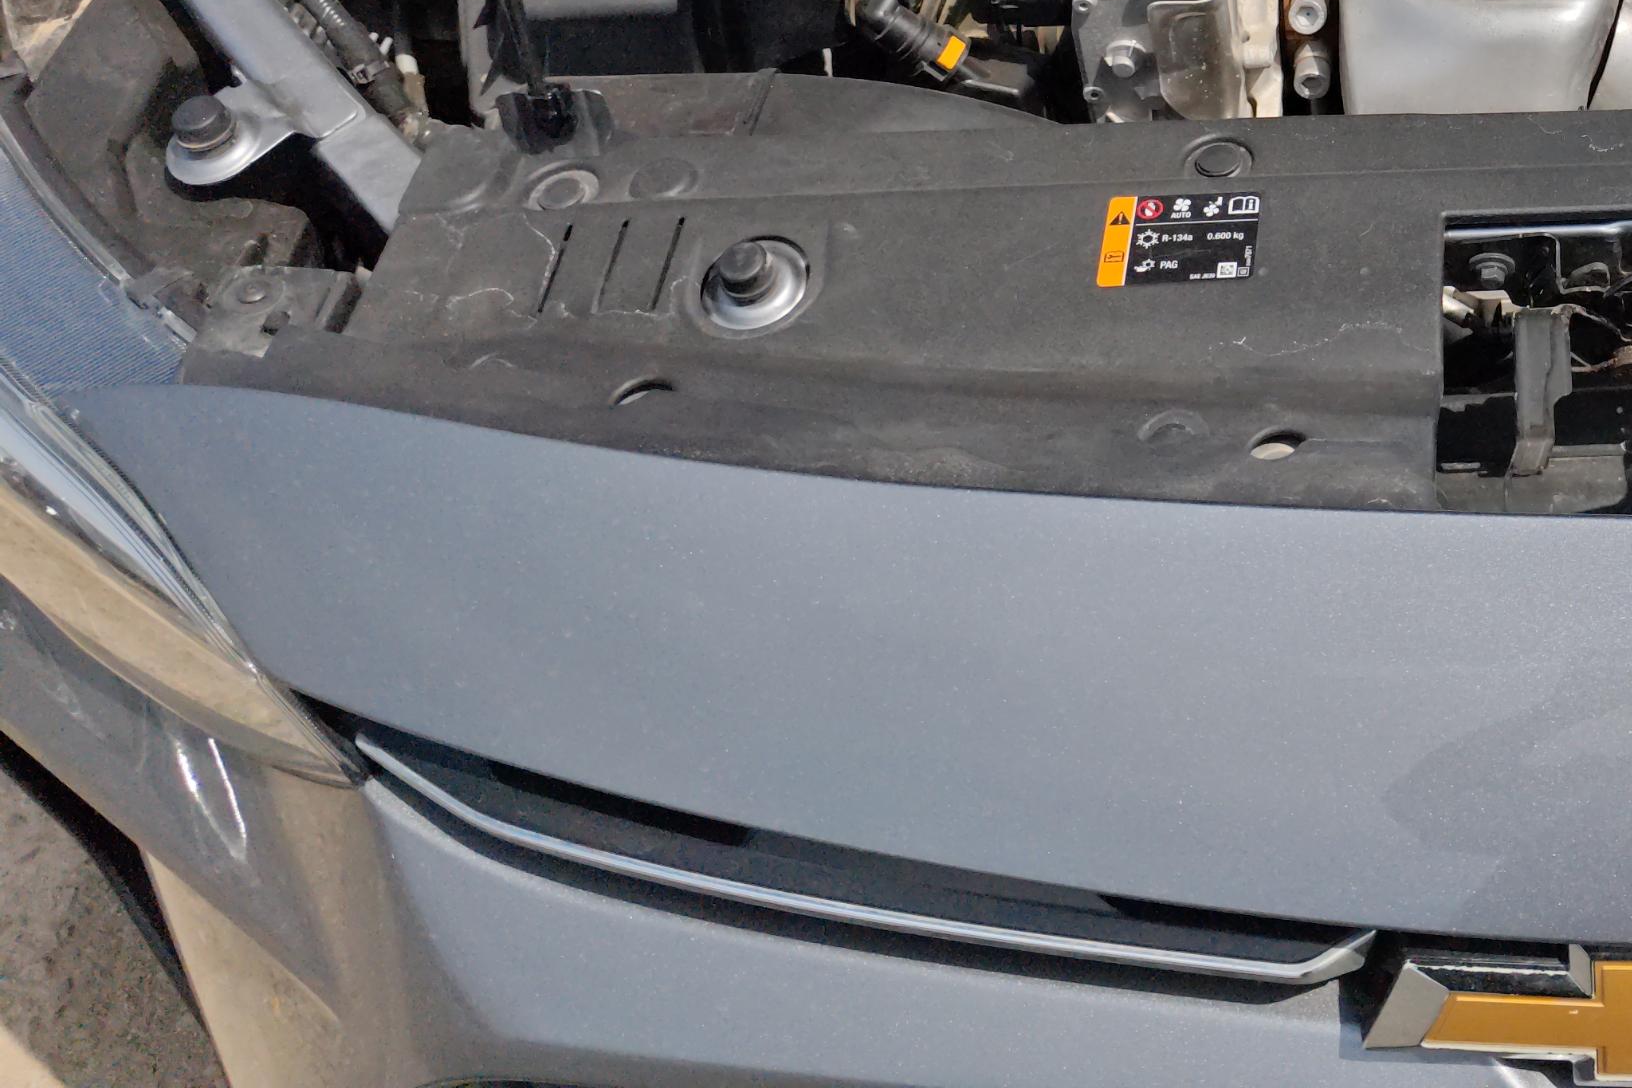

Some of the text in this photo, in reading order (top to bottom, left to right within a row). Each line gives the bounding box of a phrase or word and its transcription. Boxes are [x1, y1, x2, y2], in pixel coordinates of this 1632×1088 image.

[1170, 211, 1192, 219] AUTO
[1161, 231, 1244, 242] R-134a 0.600 kg
[1159, 260, 1179, 269] PAG
